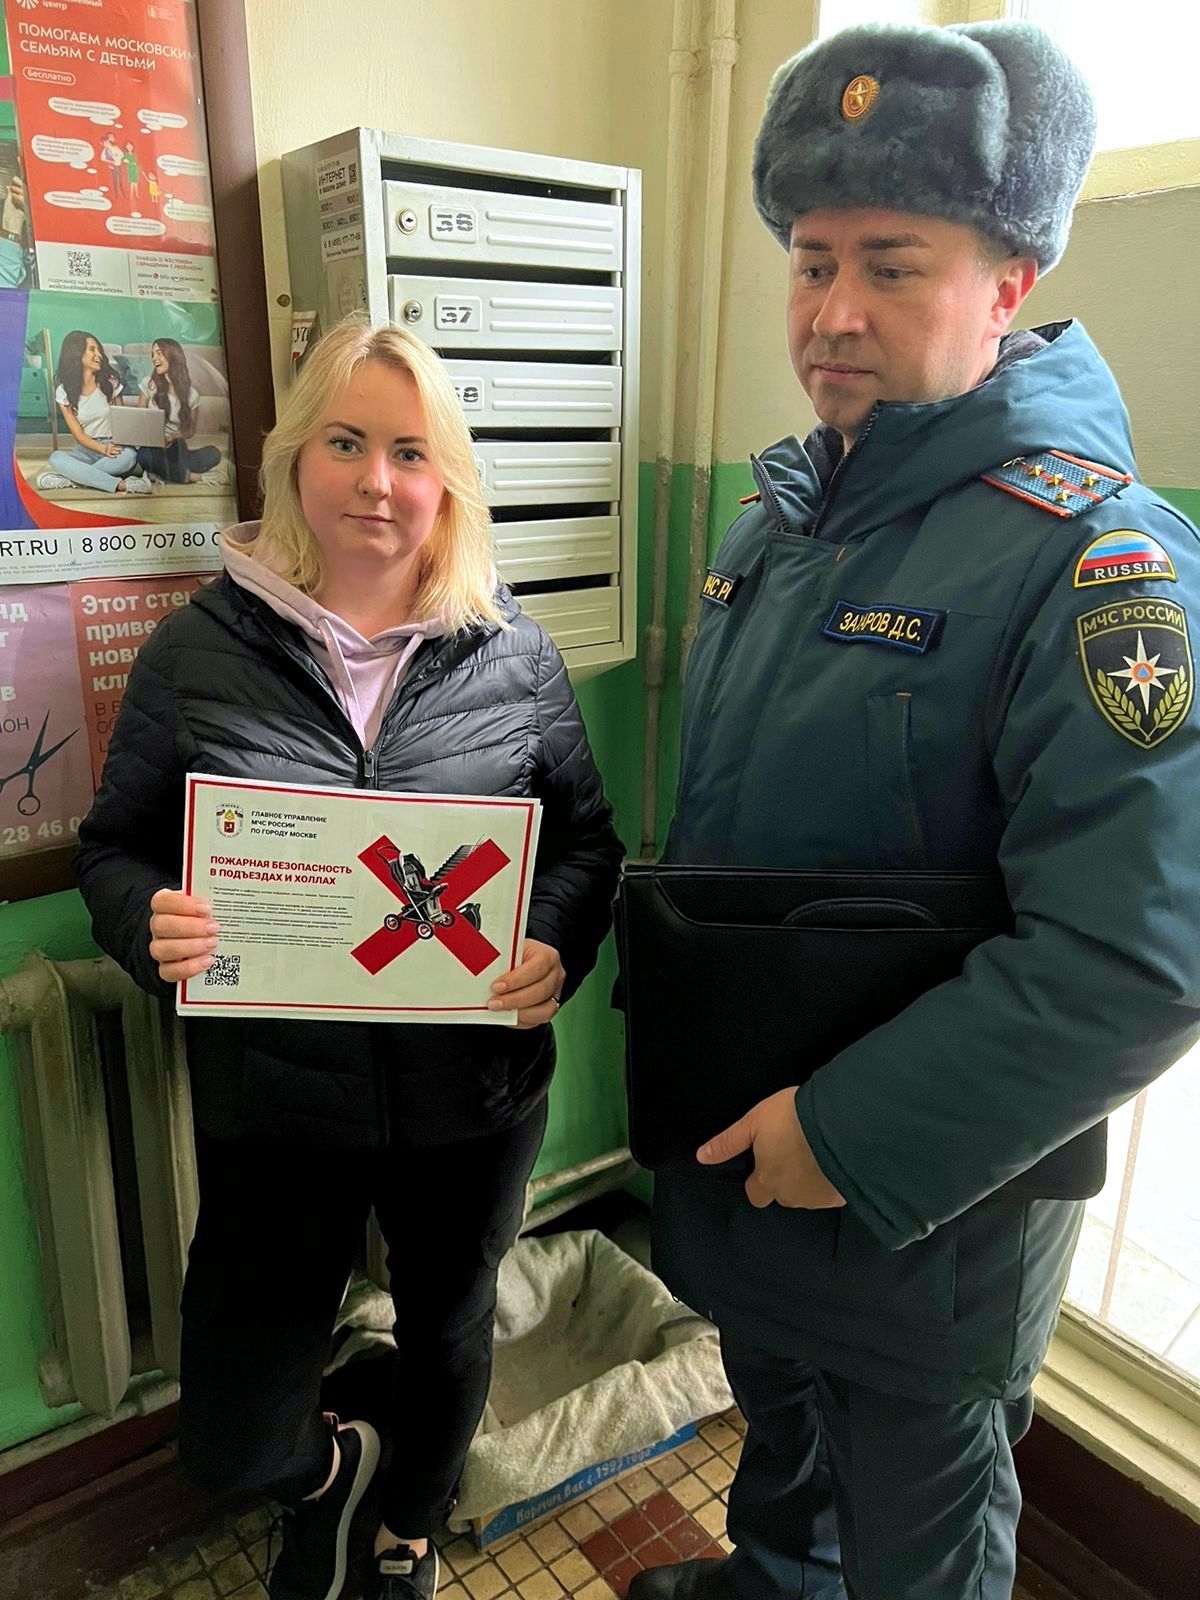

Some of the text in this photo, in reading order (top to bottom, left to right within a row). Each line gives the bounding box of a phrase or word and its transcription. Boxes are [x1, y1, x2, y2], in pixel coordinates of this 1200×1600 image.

[19, 22, 100, 46] ПОМОГАЕМ
[20, 39, 156, 71] СЕМЬЯМ С ДЕТЬМИ
[436, 213, 473, 232] 36
[441, 307, 472, 323] 37
[455, 387, 478, 403] 8
[99, 535, 136, 551] 800
[142, 533, 176, 549] 707
[182, 532, 205, 546] 80
[1094, 562, 1162, 579] RUSSIA
[81, 594, 139, 615] Этот
[1083, 605, 1183, 635] МЧС РОССИИ
[0, 717, 29, 734] ОН
[251, 811, 327, 823] ГЛАВНОЕ УПРАВЛЕНИЕ
[251, 819, 295, 829] МЧС РОССИИ
[2, 825, 30, 845] 28
[37, 820, 63, 838] 46
[262, 829, 288, 837] ГОРОДУ
[289, 831, 317, 839] МОСКВЕ
[210, 855, 352, 875] ПОЖАРНАЯ БЕЗОПАСНОСТЬ
[209, 868, 336, 885] В ПОДЪЕЗДАХ И ХОЛЛАХ
